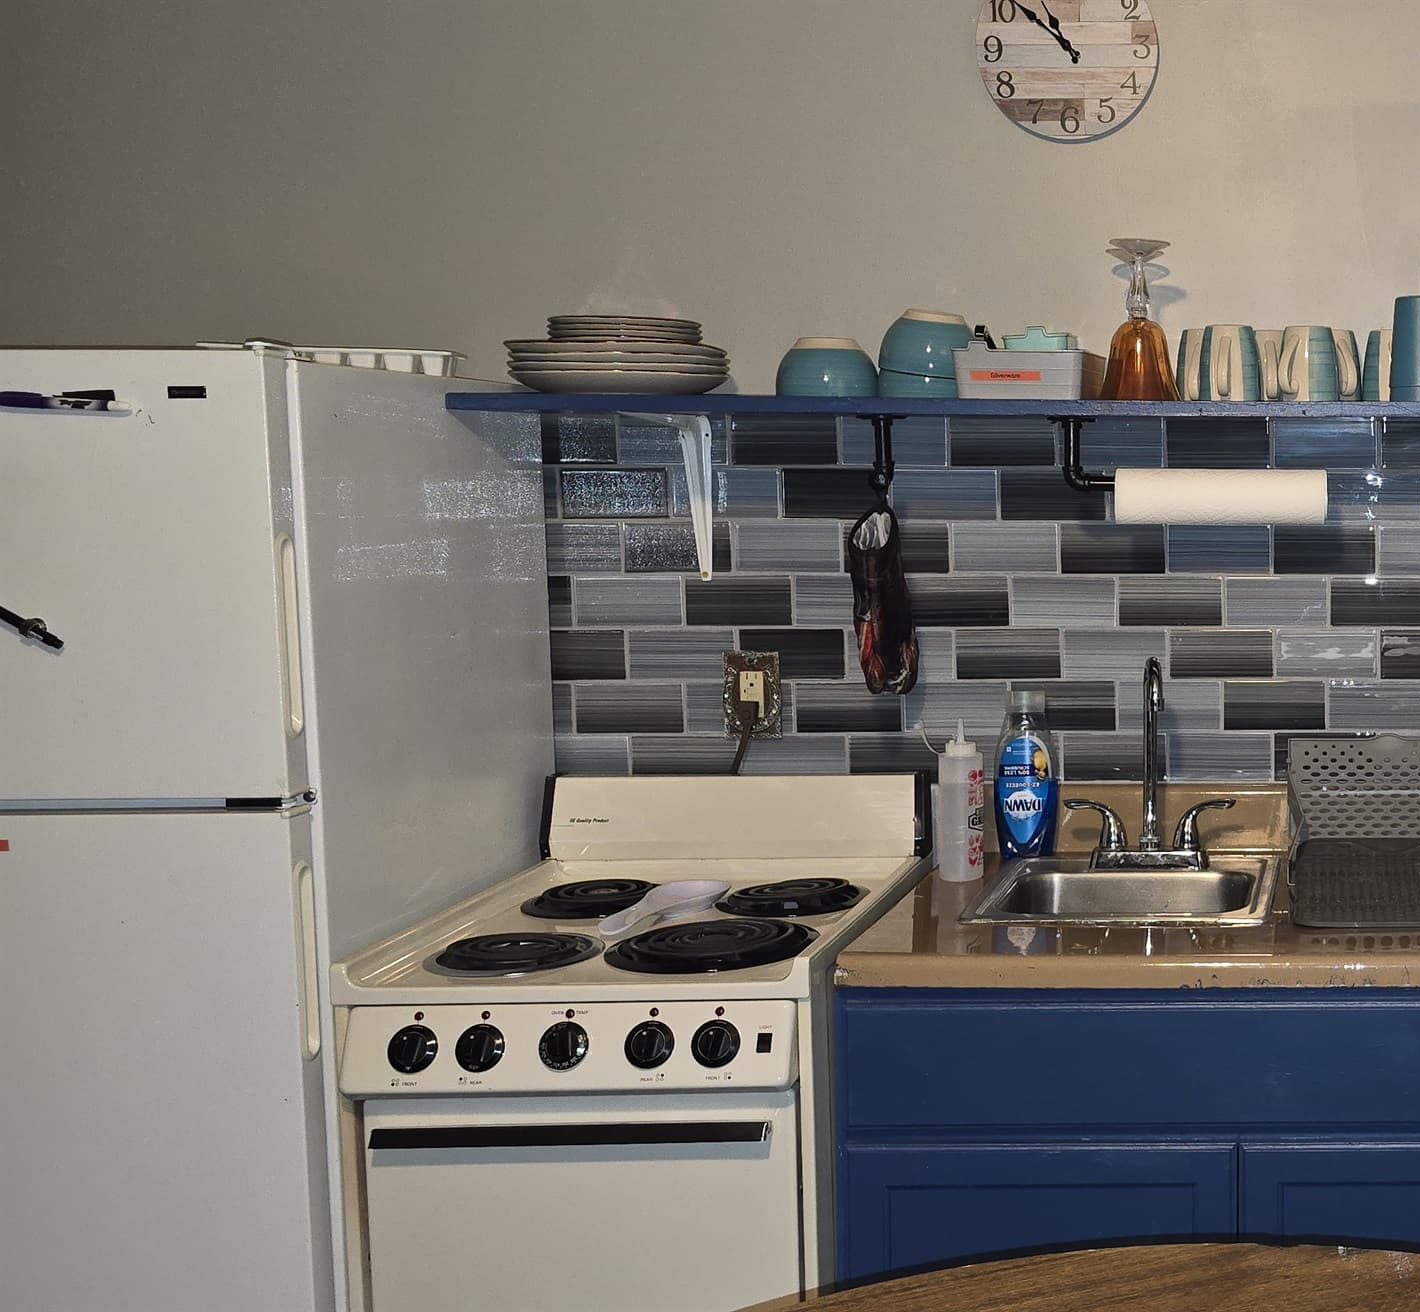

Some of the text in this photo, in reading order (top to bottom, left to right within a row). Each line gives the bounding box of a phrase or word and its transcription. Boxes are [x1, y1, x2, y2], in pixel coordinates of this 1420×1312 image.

[989, 0, 1016, 23] 10
[1121, 0, 1142, 20] 2
[984, 35, 1002, 62] 9
[1132, 34, 1151, 59] 3
[996, 71, 1015, 98] 8
[1120, 71, 1141, 95] 4
[1026, 99, 1044, 124] 7
[1060, 106, 1079, 133] 6
[1097, 97, 1116, 123] 5
[1004, 798, 1042, 812] DAWN
